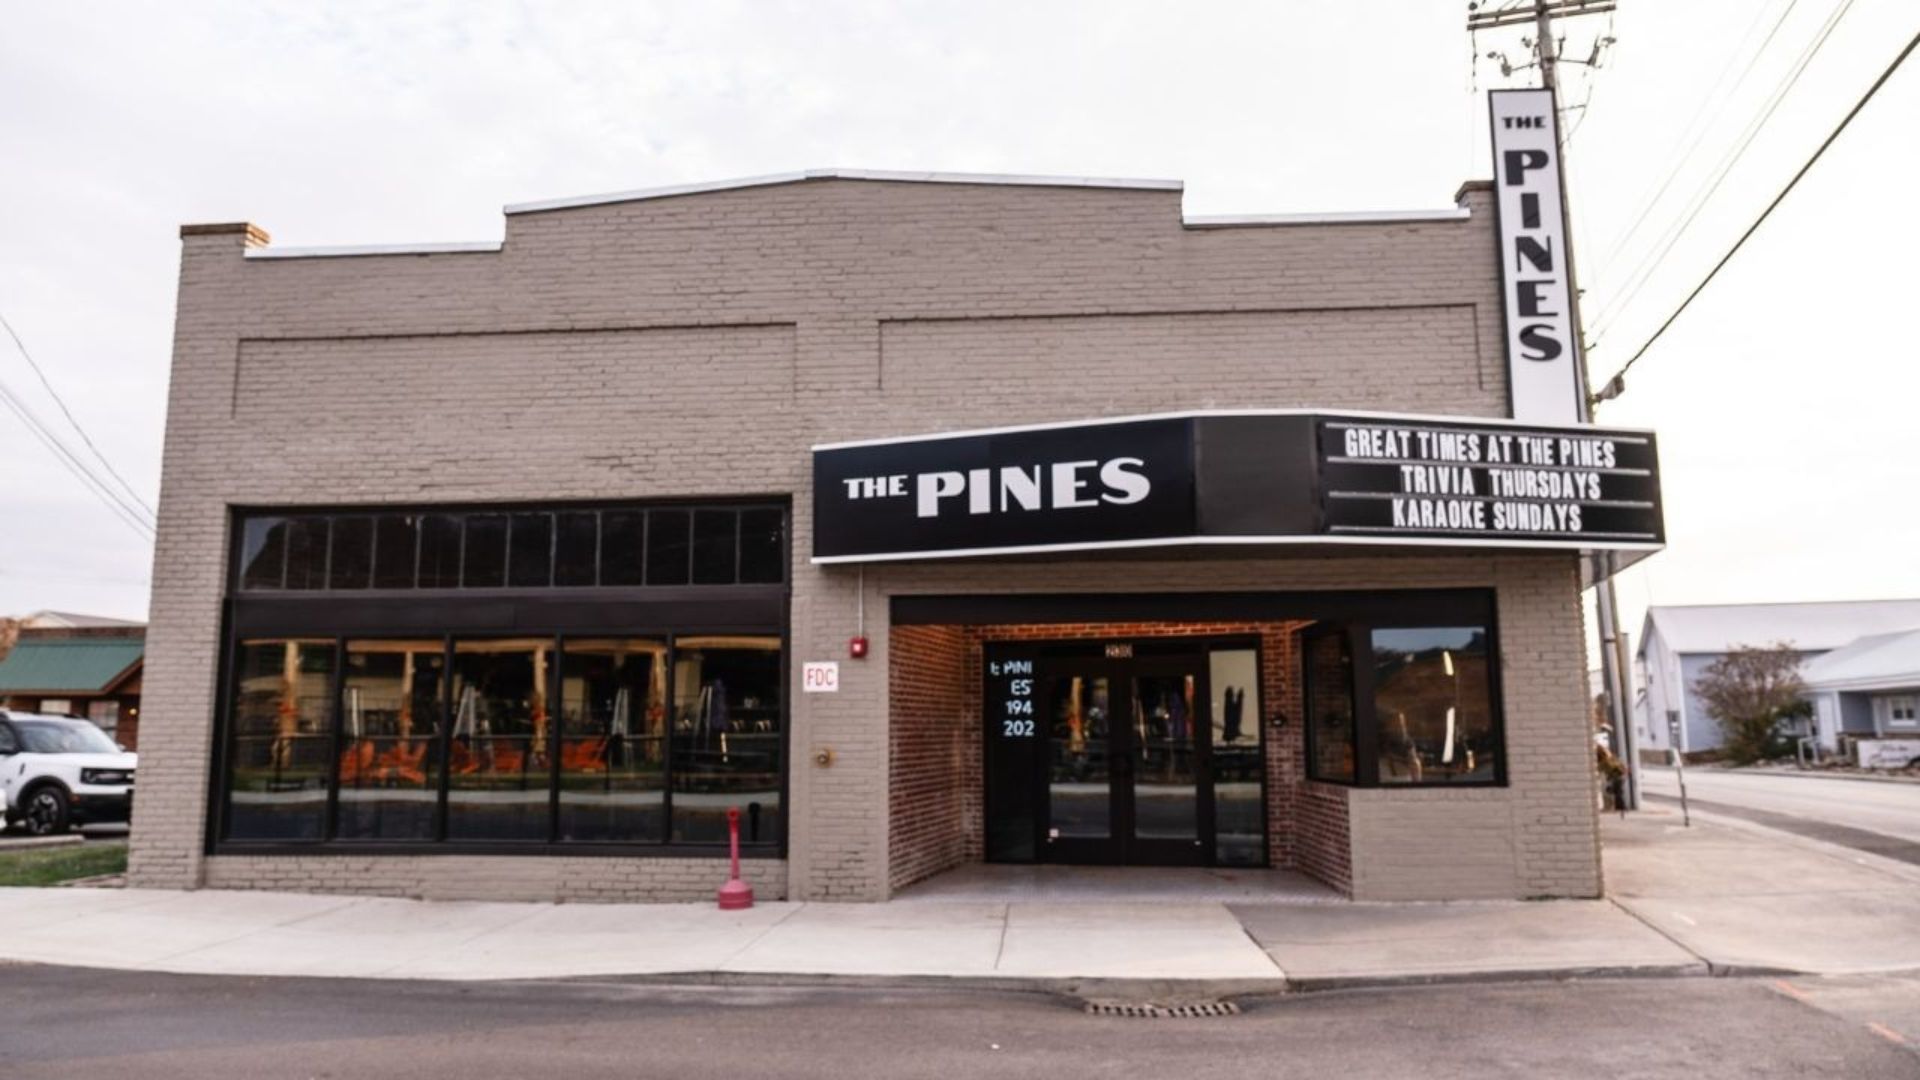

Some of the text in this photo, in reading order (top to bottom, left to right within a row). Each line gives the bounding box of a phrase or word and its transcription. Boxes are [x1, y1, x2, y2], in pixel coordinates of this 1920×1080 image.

[1501, 116, 1547, 129] THE
[1503, 149, 1562, 362] PINES
[1344, 428, 1616, 468] GREAT TIMES AT THE PINES
[842, 457, 1151, 518] THE PINES
[1400, 464, 1602, 500] TRIVIA THURSDAYS
[1392, 498, 1582, 532] KARAOKE SUNDAYS
[807, 668, 835, 687] FDC
[1006, 700, 1034, 715] 194
[1003, 720, 1035, 737] 202
